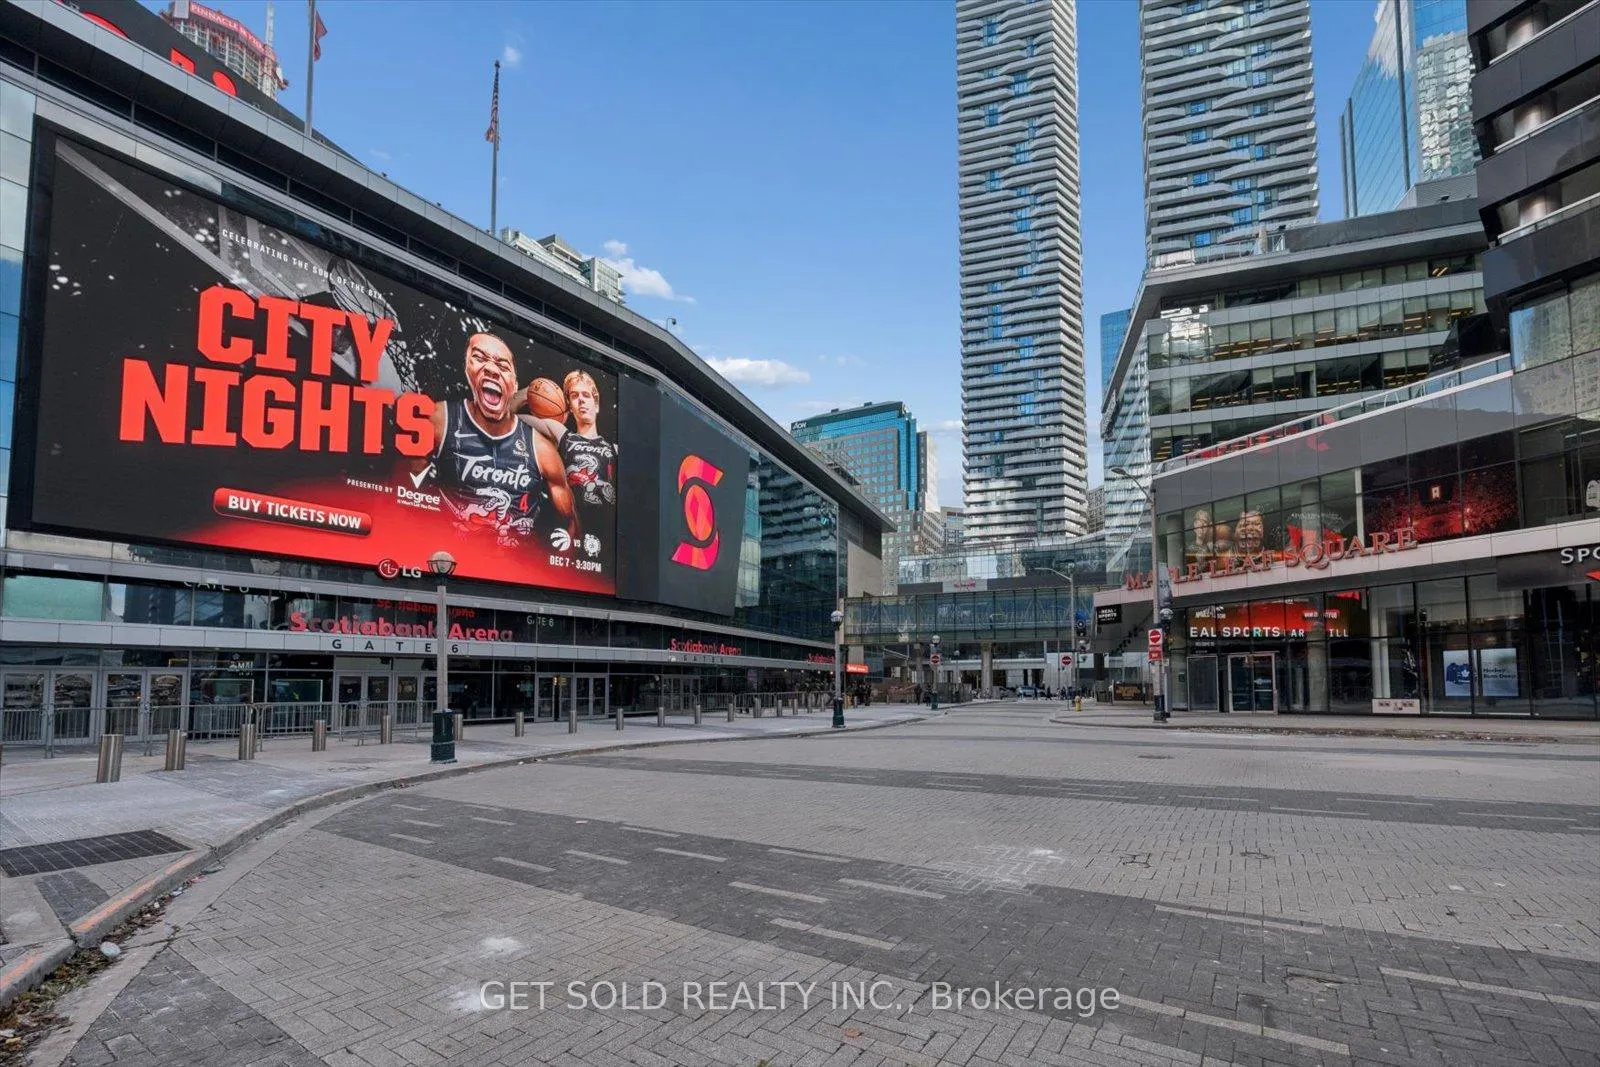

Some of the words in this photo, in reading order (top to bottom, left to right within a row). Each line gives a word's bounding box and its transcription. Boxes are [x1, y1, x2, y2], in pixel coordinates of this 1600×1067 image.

[222, 229, 288, 262] CELEBRATING
[292, 257, 308, 271] THE
[312, 266, 334, 281] SOUL
[337, 275, 348, 285] OF
[350, 281, 365, 294] THE
[197, 285, 395, 382] CITY
[119, 358, 435, 457] NIGHTS
[566, 440, 614, 458] Toronto
[453, 451, 532, 490] Toronto
[347, 478, 383, 492] PRESENTED
[397, 485, 441, 505] Degree
[228, 495, 265, 513] BUY
[266, 501, 325, 524] TICKETS
[328, 511, 363, 529] NOW
[519, 493, 529, 513] 4
[550, 555, 565, 566] DEC
[565, 557, 570, 566] 7
[575, 558, 602, 572] 3:30PM
[1126, 562, 1203, 591] MALE
[1210, 551, 1273, 579] LEAF
[1285, 527, 1418, 570] SQUARE
[402, 565, 422, 578] LG
[289, 612, 438, 638] Scotiabank
[448, 622, 513, 642] Arena
[1190, 626, 1217, 637] EAL
[1222, 626, 1281, 638] SPORTS
[1290, 629, 1305, 638] AR
[1329, 628, 1349, 638] ILL
[332, 639, 431, 653] GATE
[451, 644, 459, 653] 6
[671, 638, 718, 654] Scotiabank
[719, 643, 742, 656] Arena
